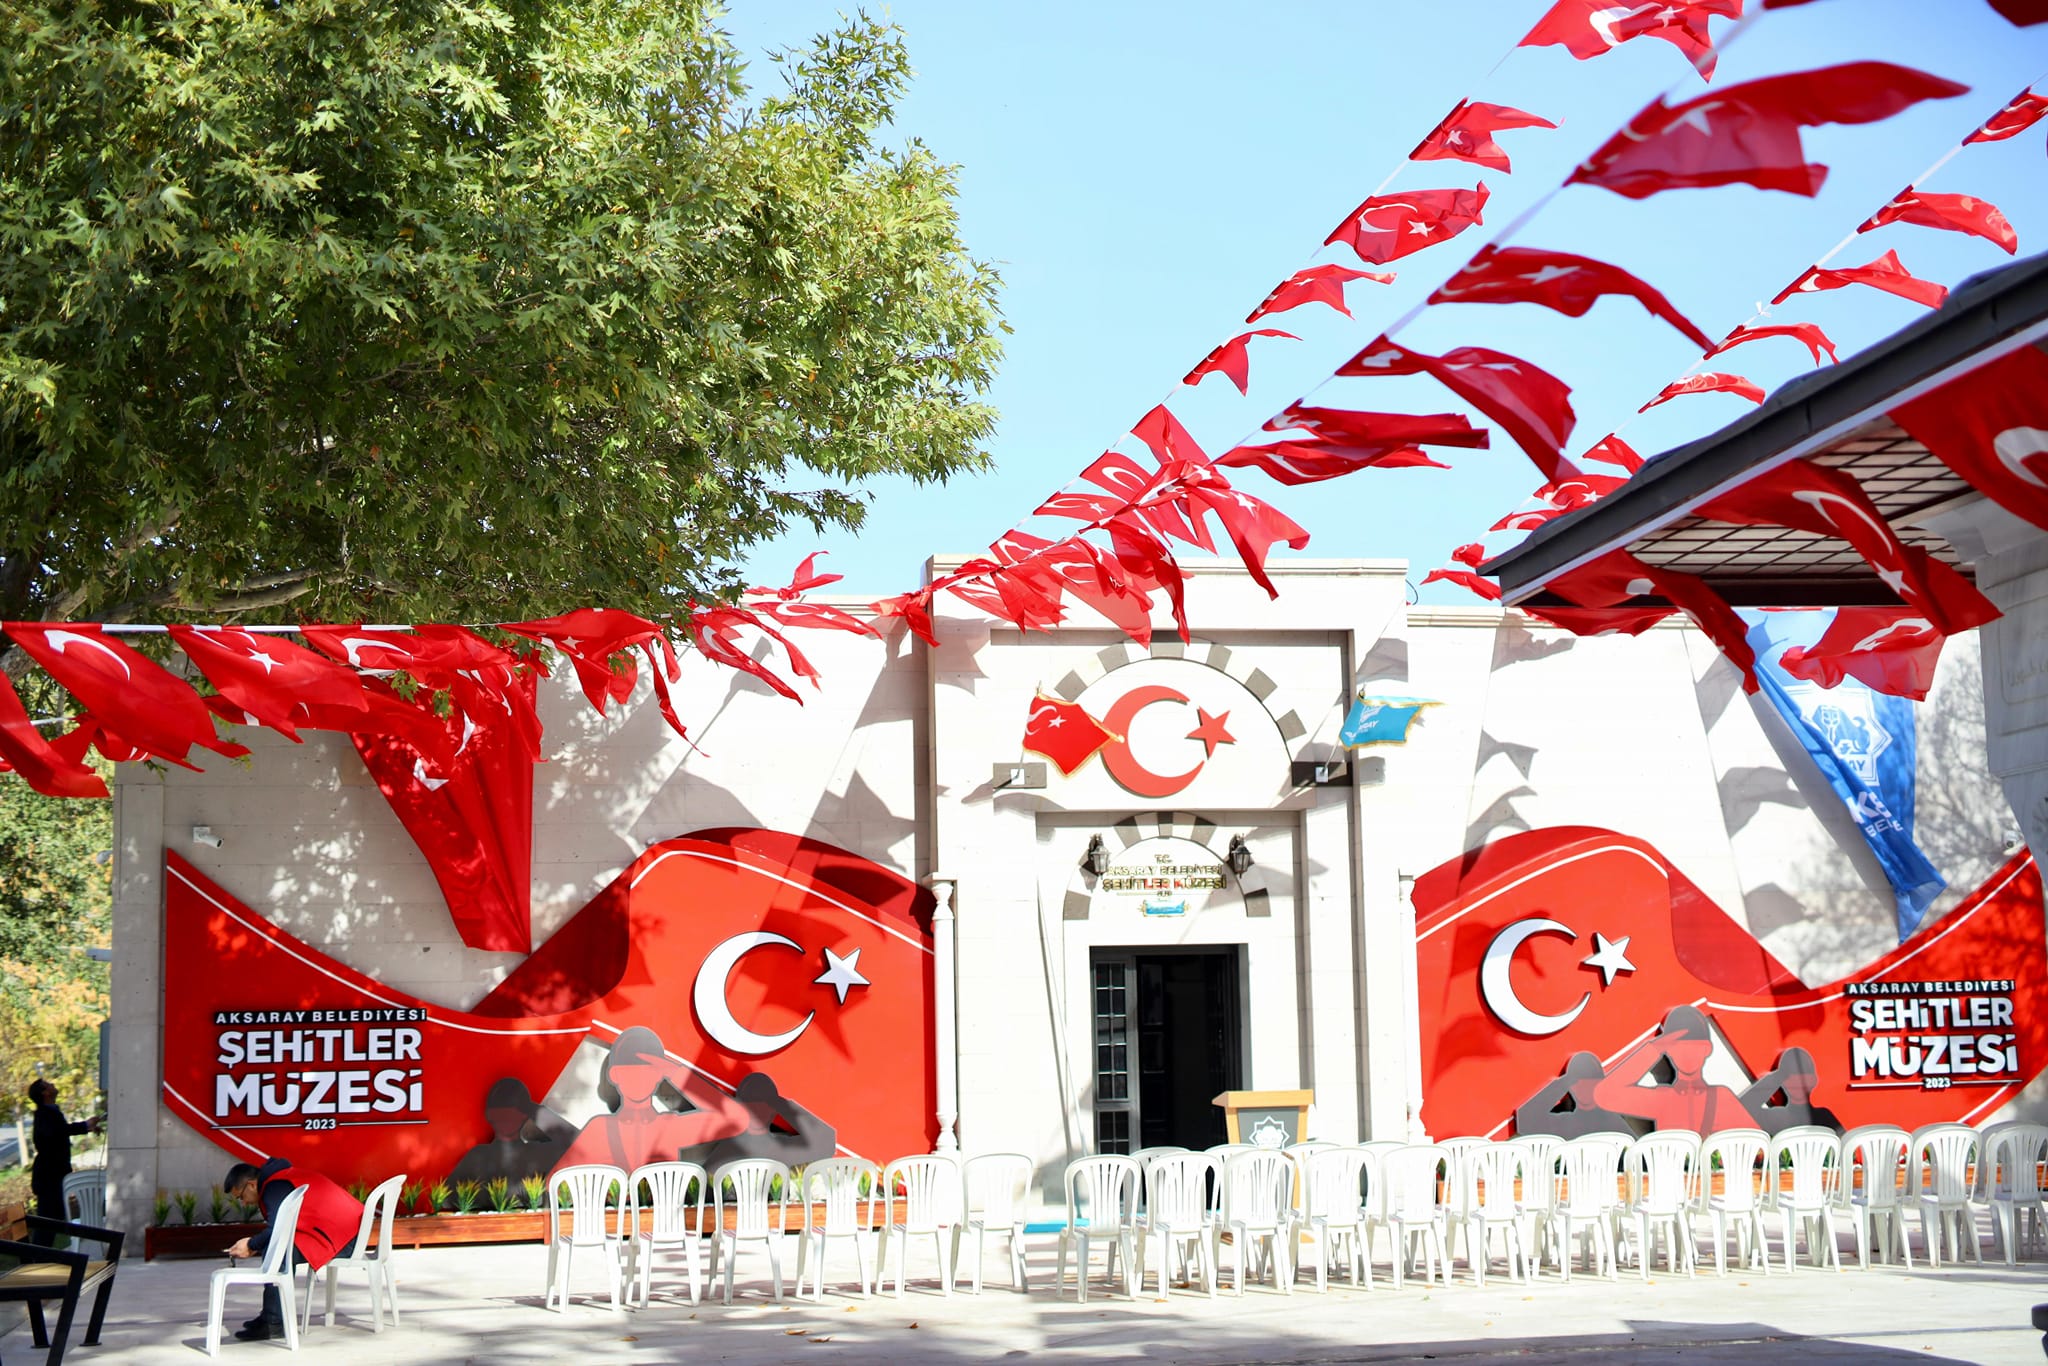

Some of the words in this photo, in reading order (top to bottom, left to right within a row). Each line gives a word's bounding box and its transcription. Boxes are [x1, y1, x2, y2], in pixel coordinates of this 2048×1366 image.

[1107, 865, 1157, 876] AKSARAY
[1102, 876, 1171, 892] ŞEHİTLER
[1174, 875, 1227, 890] MÜZESİ
[1849, 982, 1920, 994] AKSARAY
[1924, 980, 2015, 993] BELEDİYESİ
[216, 1011, 305, 1024] AKSARAY
[312, 1009, 426, 1022] BELEDİYESİ
[1852, 997, 2014, 1033] ŞEHİTLER
[218, 1028, 422, 1068] ŞEHİTLER
[1852, 1034, 2018, 1076] MÜZESİ
[1925, 1077, 1951, 1089] 2023
[216, 1069, 422, 1117] MÜZESİ
[304, 1119, 336, 1130] 2023
